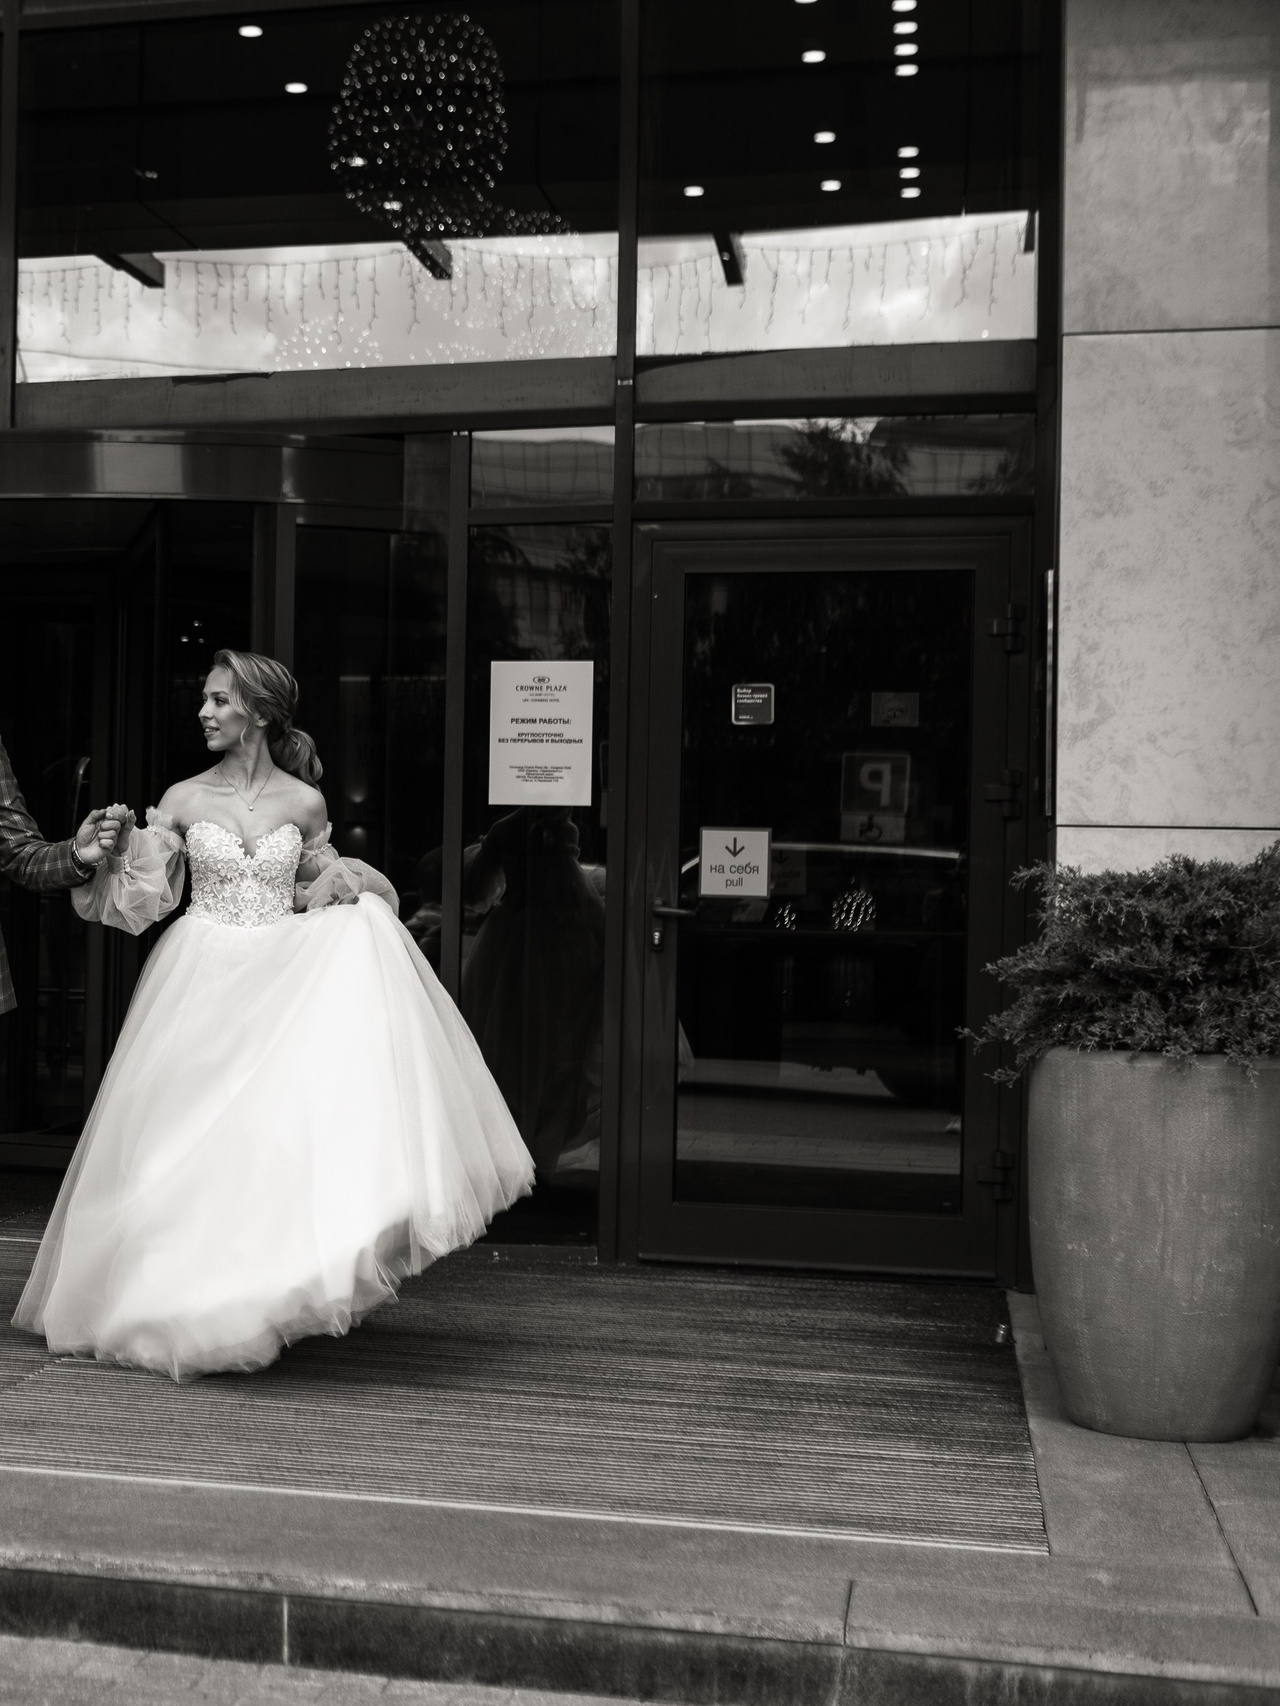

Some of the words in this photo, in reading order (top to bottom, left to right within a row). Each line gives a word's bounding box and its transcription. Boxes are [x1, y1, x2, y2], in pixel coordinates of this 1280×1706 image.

[709, 864, 725, 874] на
[729, 861, 759, 874] себя
[725, 877, 743, 889] pull
